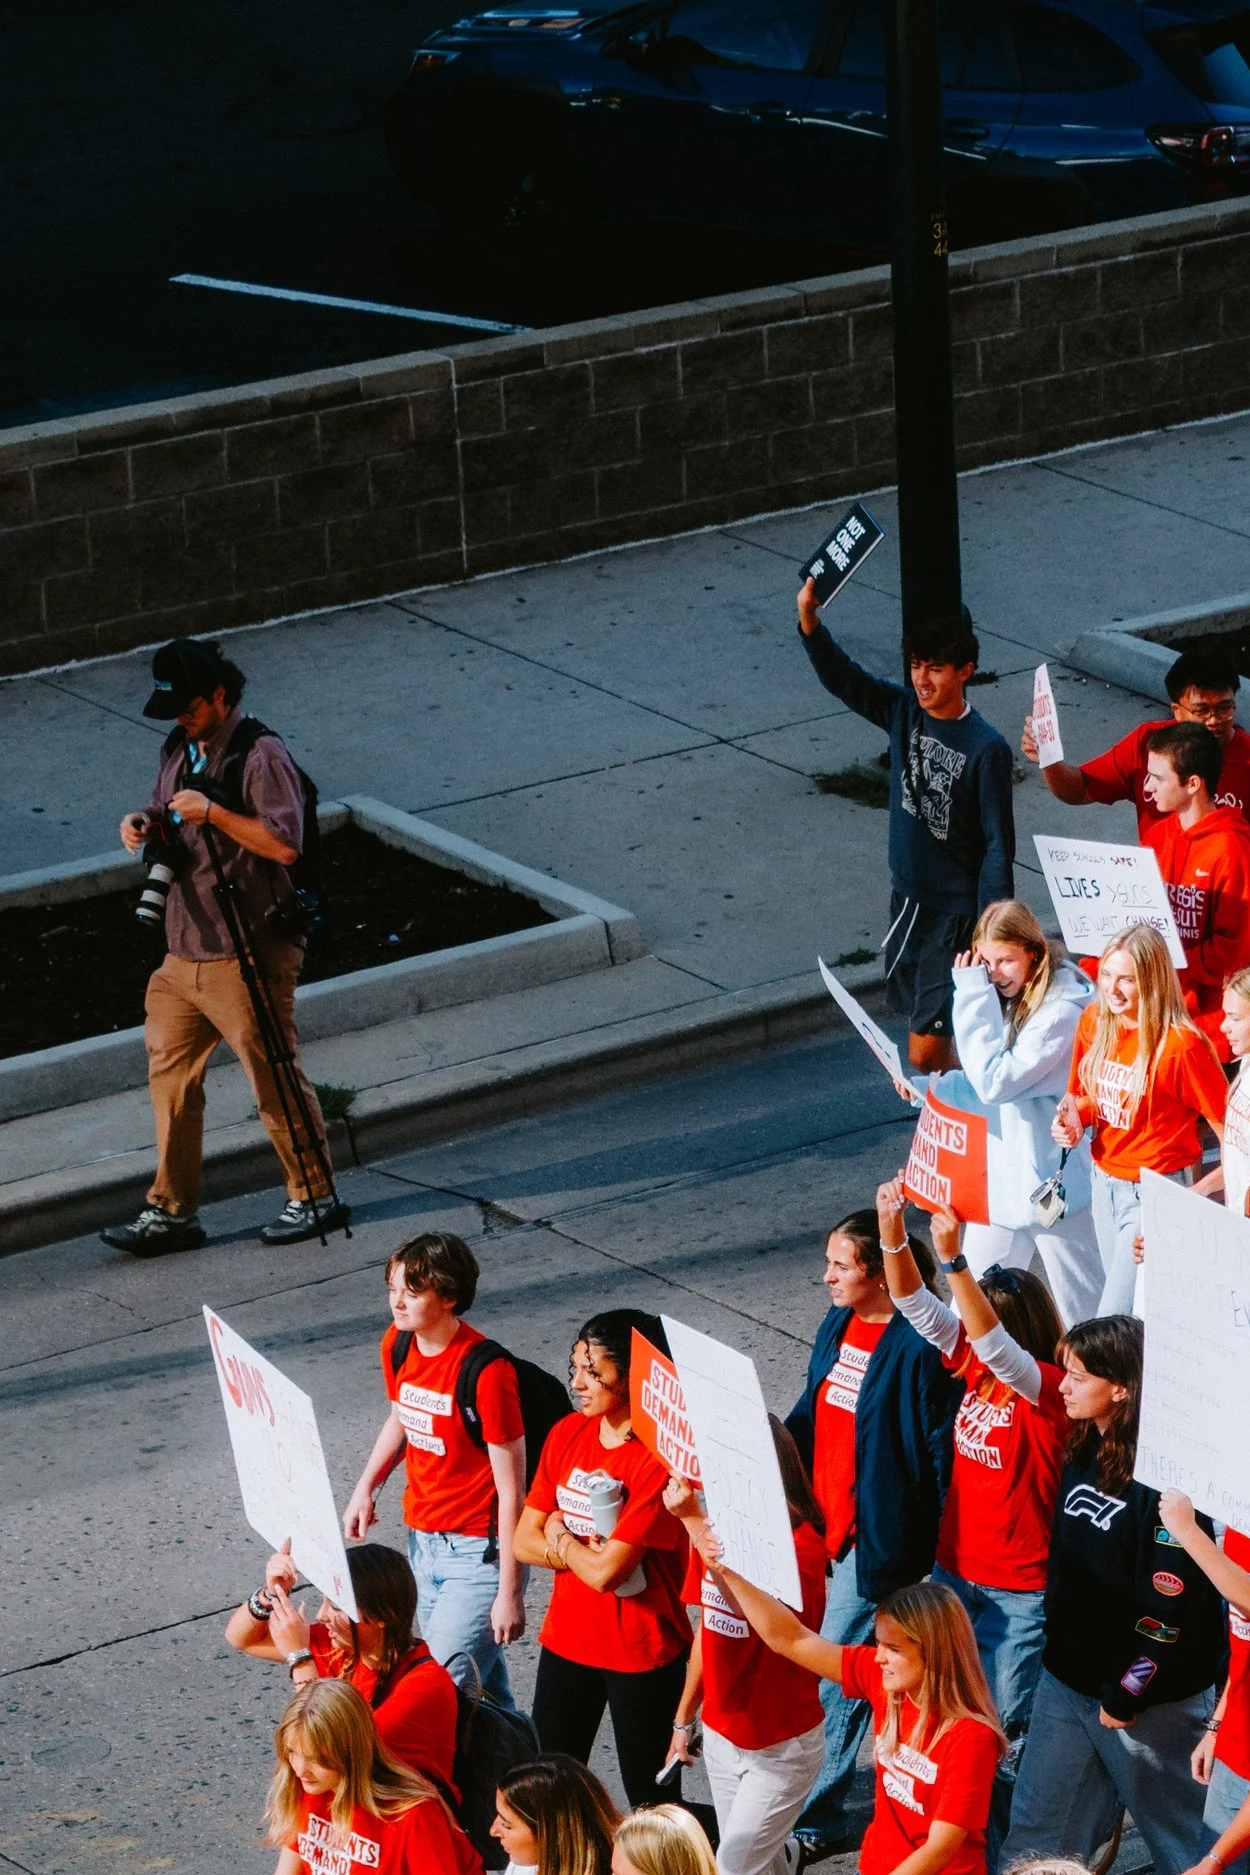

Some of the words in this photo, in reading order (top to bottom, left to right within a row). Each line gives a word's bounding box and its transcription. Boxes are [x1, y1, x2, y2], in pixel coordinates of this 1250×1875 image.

[846, 516, 867, 540] NOT
[836, 529, 856, 553] ONE
[826, 540, 850, 571] MORE
[1055, 876, 1100, 899] LIVES
[906, 1162, 947, 1204] ACTION
[841, 1348, 870, 1368] Stude
[404, 1389, 447, 1412] Students
[659, 1433, 701, 1477] ACTIO
[568, 1519, 598, 1537] Actio
[707, 1613, 744, 1634] Action
[300, 1836, 348, 1875] DEMAND
